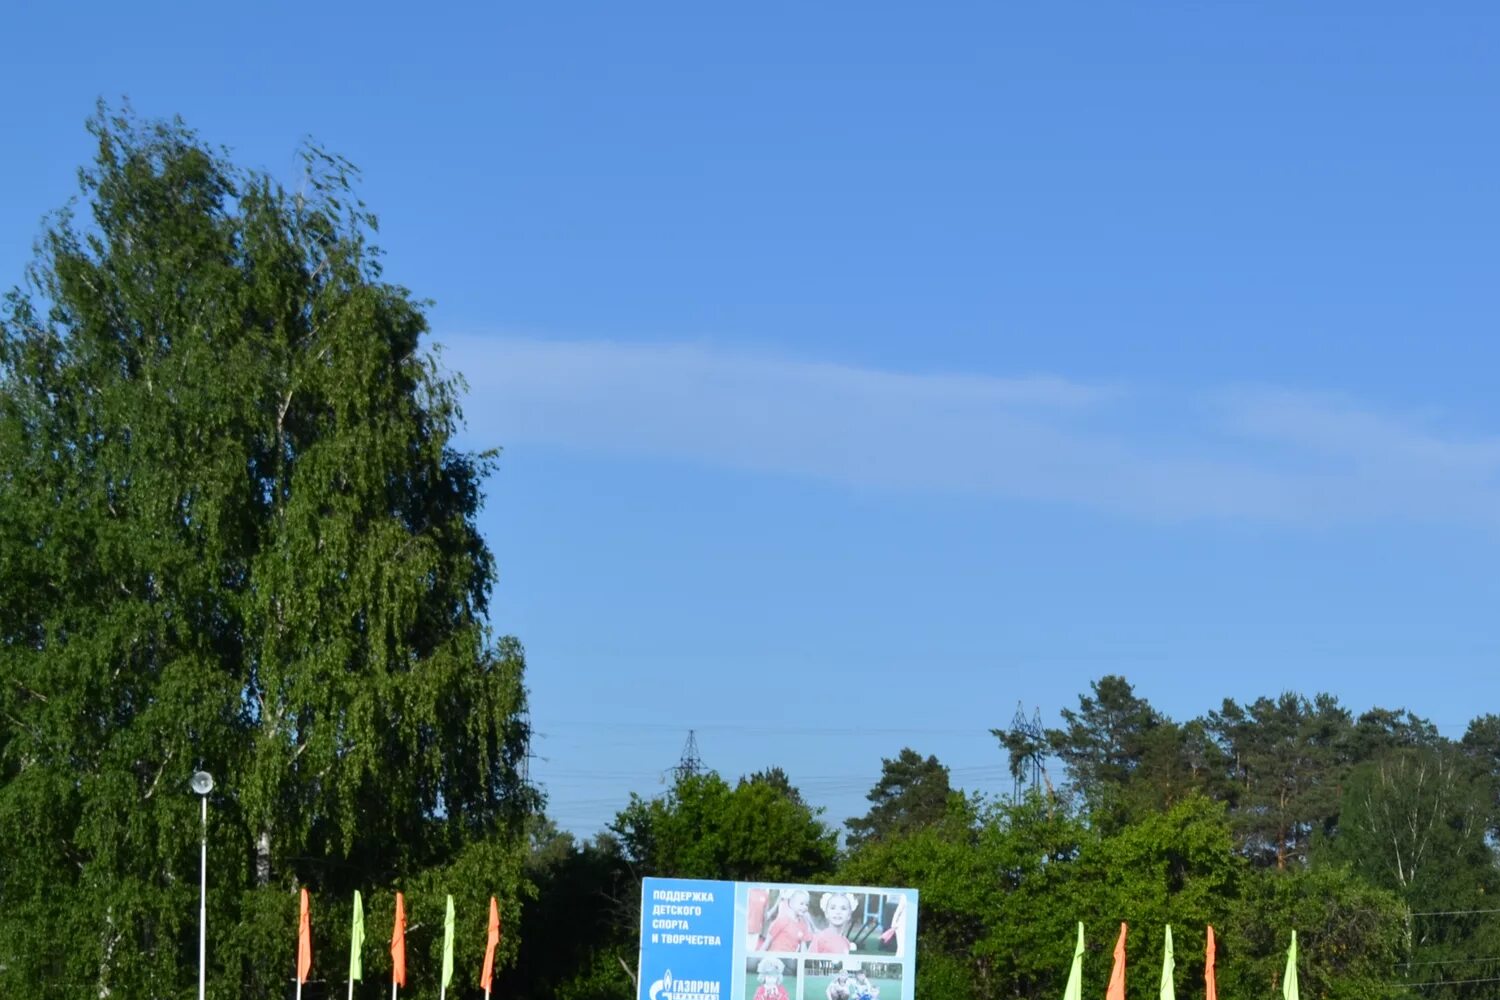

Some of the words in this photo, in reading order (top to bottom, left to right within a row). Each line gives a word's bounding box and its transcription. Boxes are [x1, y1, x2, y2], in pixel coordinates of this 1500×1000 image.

[653, 890, 714, 902] ПОДДЕРЖКА
[652, 904, 702, 916] ДЕТСКОГО
[652, 919, 689, 930] СПОРТА
[652, 933, 659, 944] И
[661, 934, 721, 946] ТВОРЧЕСТВА
[672, 979, 720, 994] ГАЗПРОМ
